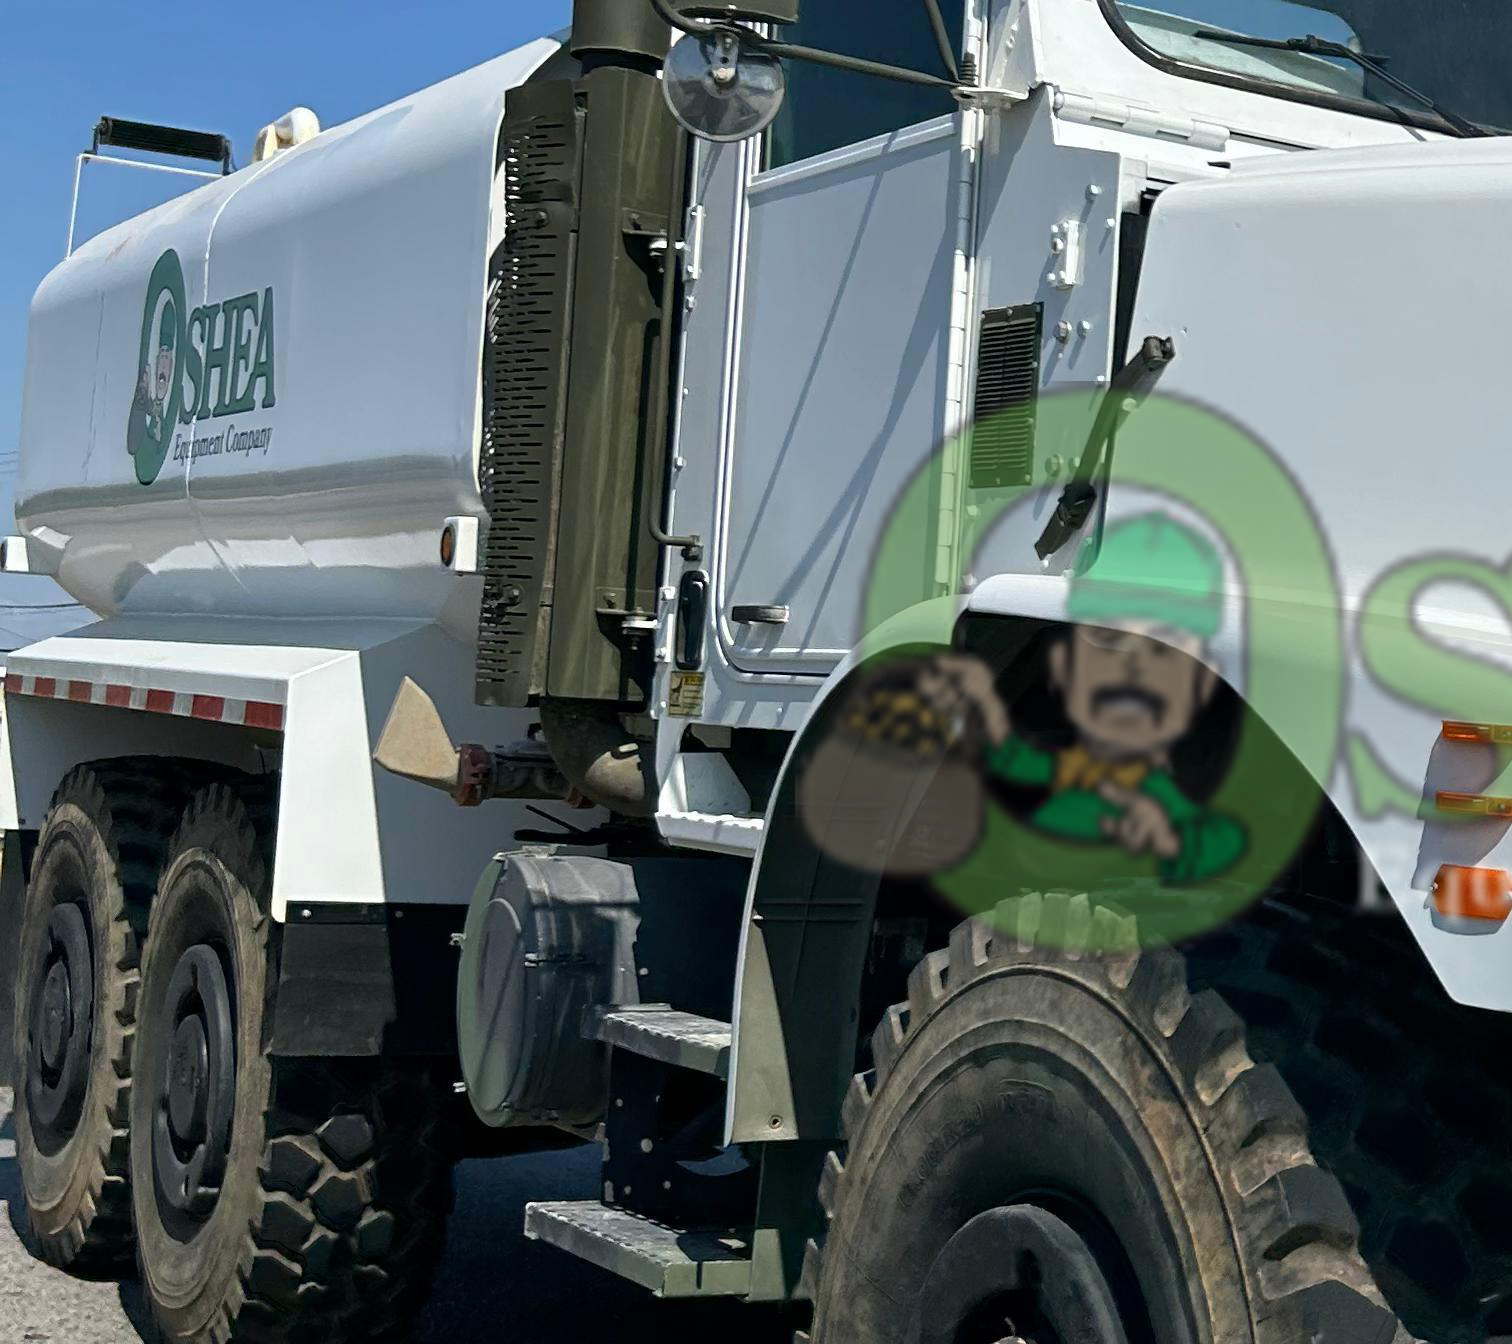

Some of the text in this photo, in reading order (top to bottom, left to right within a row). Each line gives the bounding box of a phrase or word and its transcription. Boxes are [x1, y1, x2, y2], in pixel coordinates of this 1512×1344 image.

[132, 248, 276, 485] OSHEA
[173, 423, 273, 466] Equipment Company
